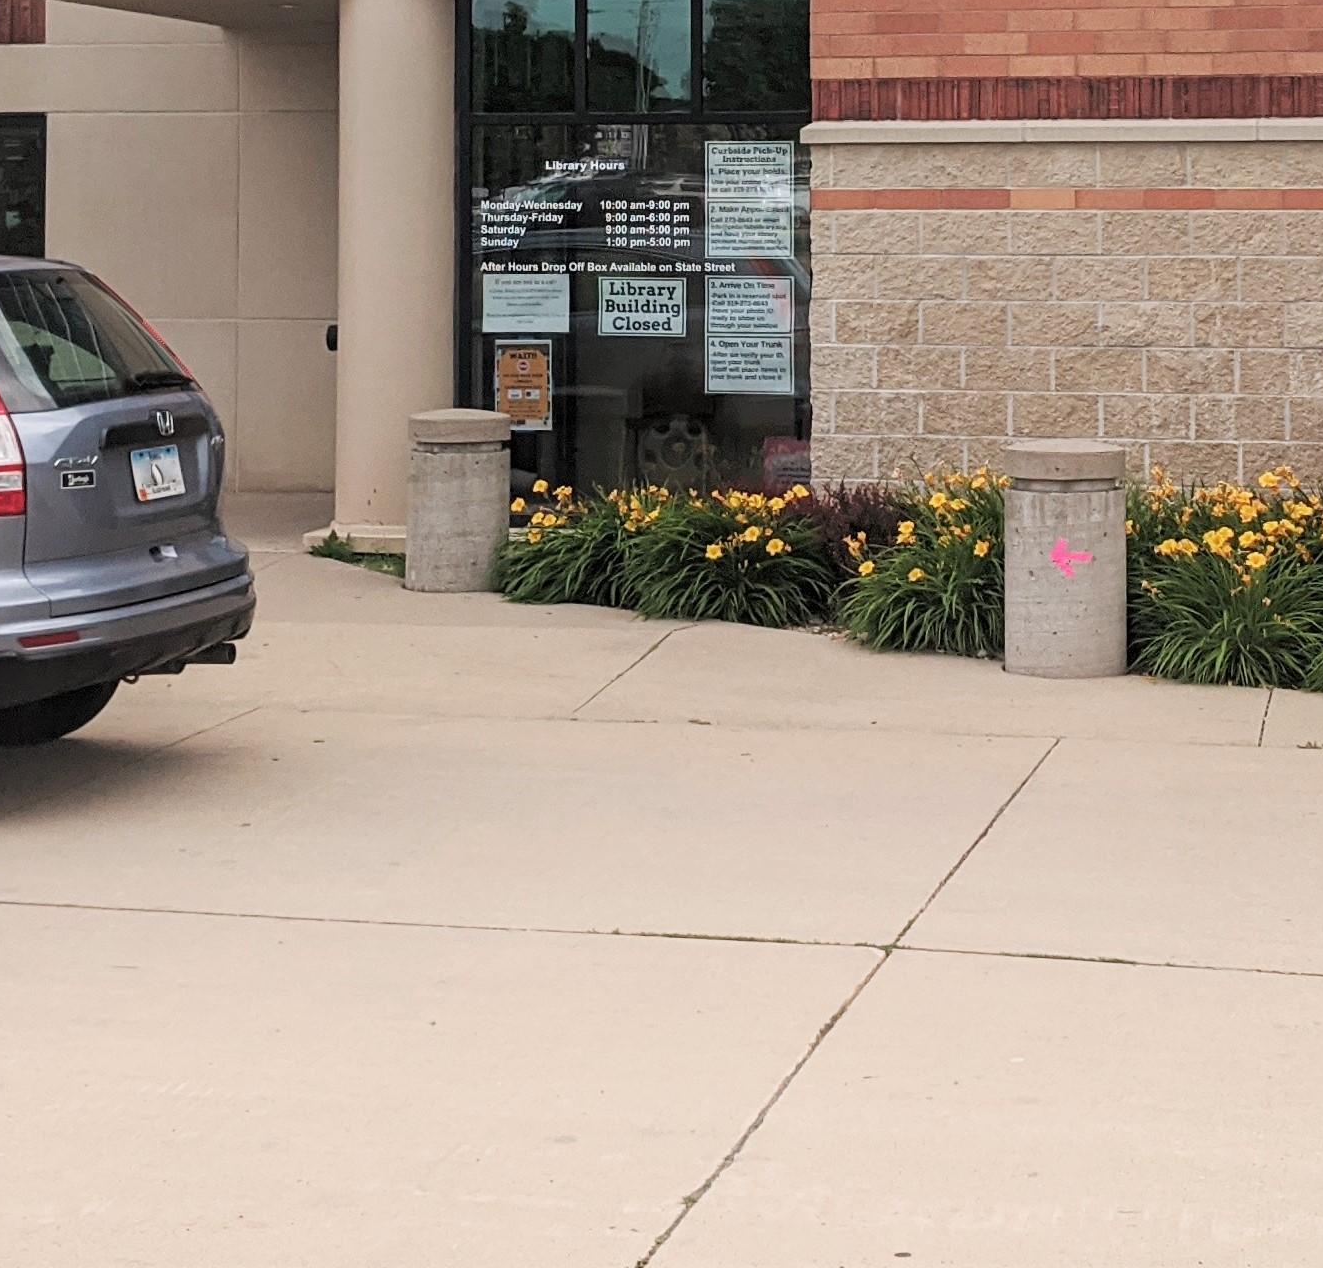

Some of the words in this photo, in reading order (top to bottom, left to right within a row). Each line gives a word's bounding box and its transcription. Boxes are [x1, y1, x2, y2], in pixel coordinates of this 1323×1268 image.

[711, 146, 751, 154] Curbside
[753, 146, 788, 156] Pick-Up
[722, 155, 777, 163] Instructions
[545, 160, 587, 172] Library
[590, 160, 625, 171] Hours
[480, 200, 583, 212] Monday-Wednesday
[599, 200, 627, 210] 10:00
[673, 202, 690, 212] pm
[480, 212, 564, 224] Thursday-Friday
[605, 213, 628, 222] 9:00
[673, 214, 690, 224] pm
[480, 225, 526, 236] Saturday
[605, 225, 628, 235] 9:00
[673, 226, 690, 236] pm
[480, 237, 519, 249] Sunday
[605, 237, 628, 247] 1:00
[673, 238, 691, 249] pm
[480, 262, 506, 272] After
[508, 262, 539, 272] Hours
[541, 262, 567, 273] Drop
[568, 262, 585, 272] Off
[587, 262, 608, 272] Box
[609, 262, 657, 272] Available
[659, 264, 673, 272] on
[675, 262, 702, 272] State
[704, 262, 736, 272] Street
[609, 281, 677, 300] Library
[604, 299, 681, 318] Building
[612, 316, 673, 331] Closed
[718, 340, 739, 348] Open
[741, 340, 760, 348] Your
[761, 340, 783, 348] Trunk
